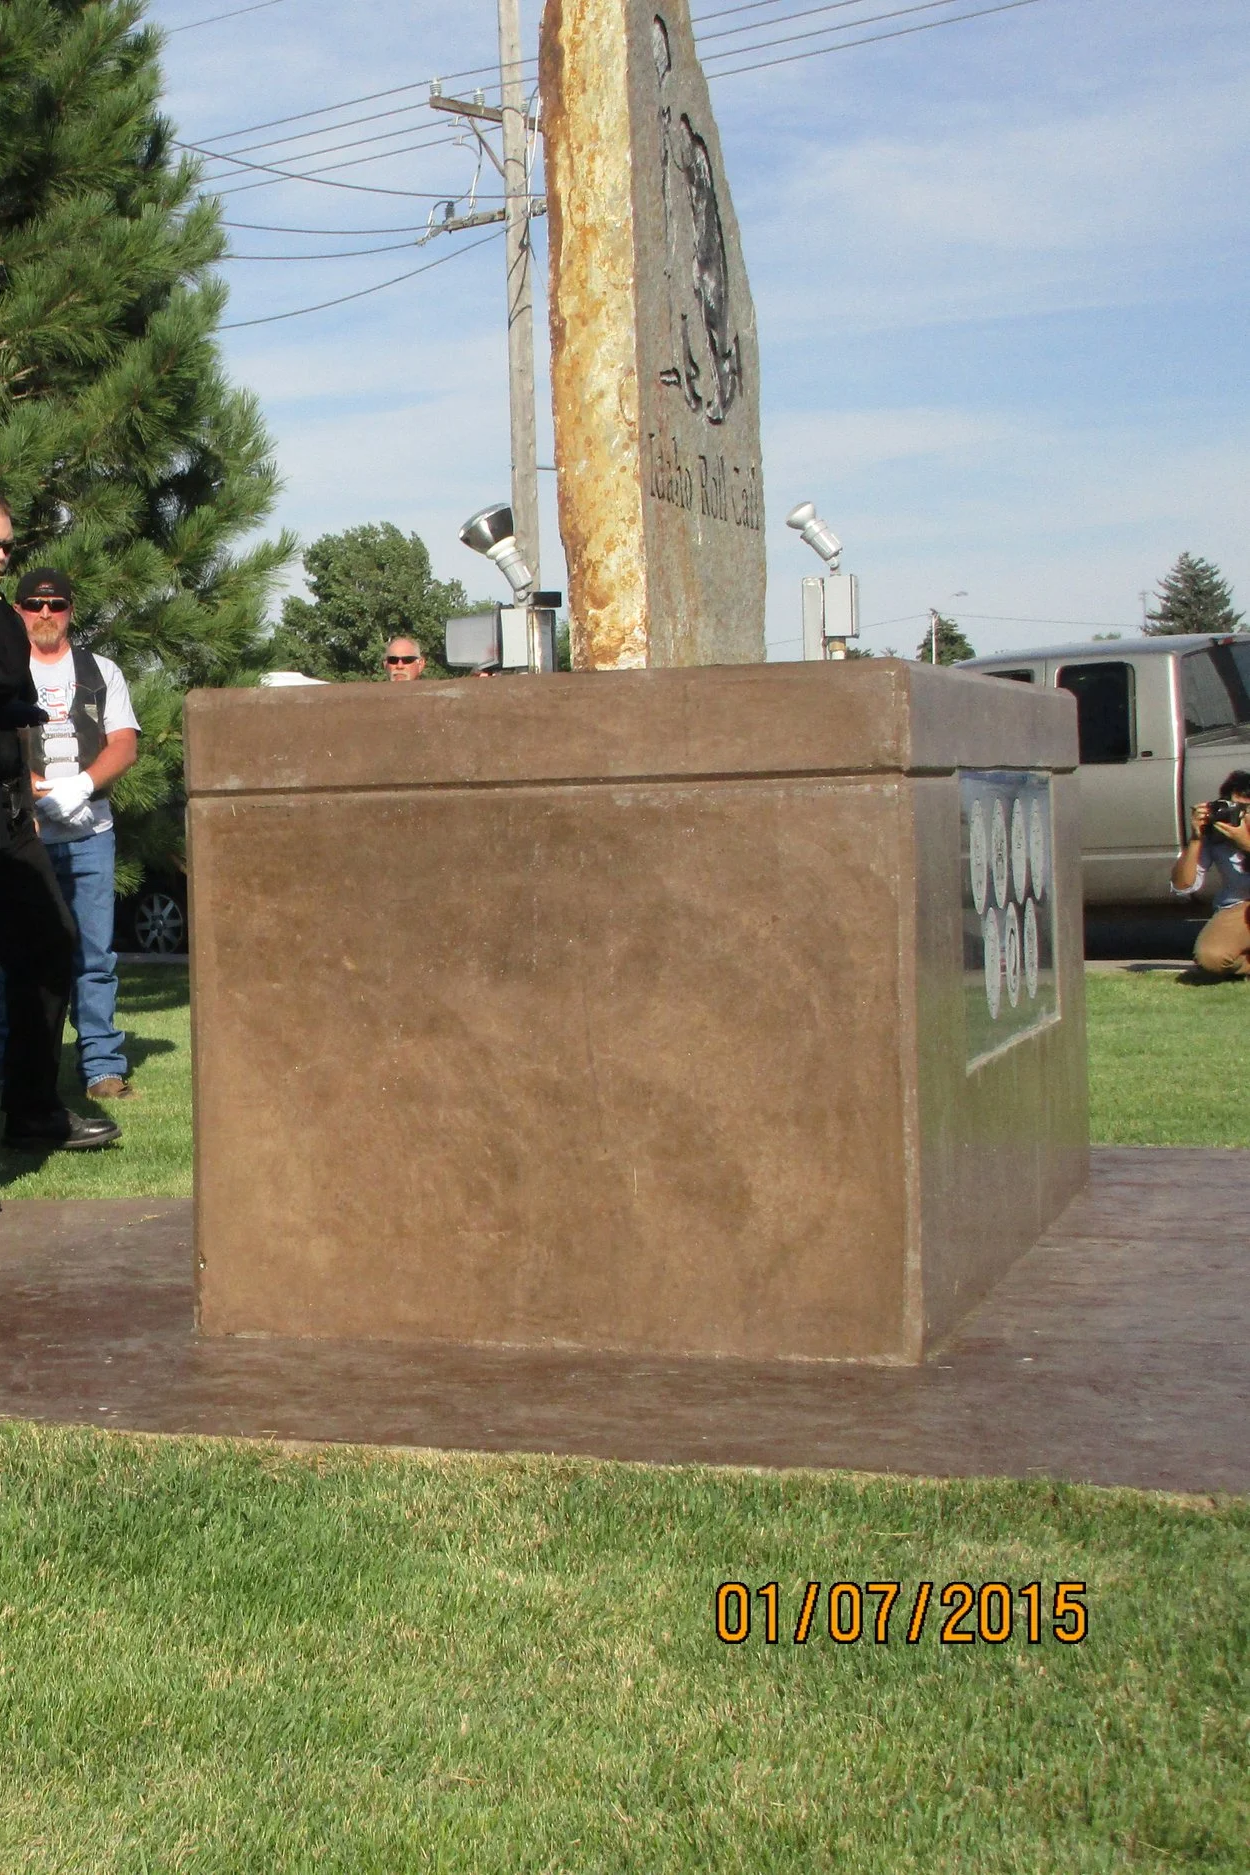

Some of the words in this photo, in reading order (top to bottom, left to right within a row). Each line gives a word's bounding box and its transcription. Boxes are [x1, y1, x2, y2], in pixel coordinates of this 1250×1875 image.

[648, 431, 693, 511] Idaho
[698, 454, 728, 522] Roll
[731, 464, 760, 531] Call
